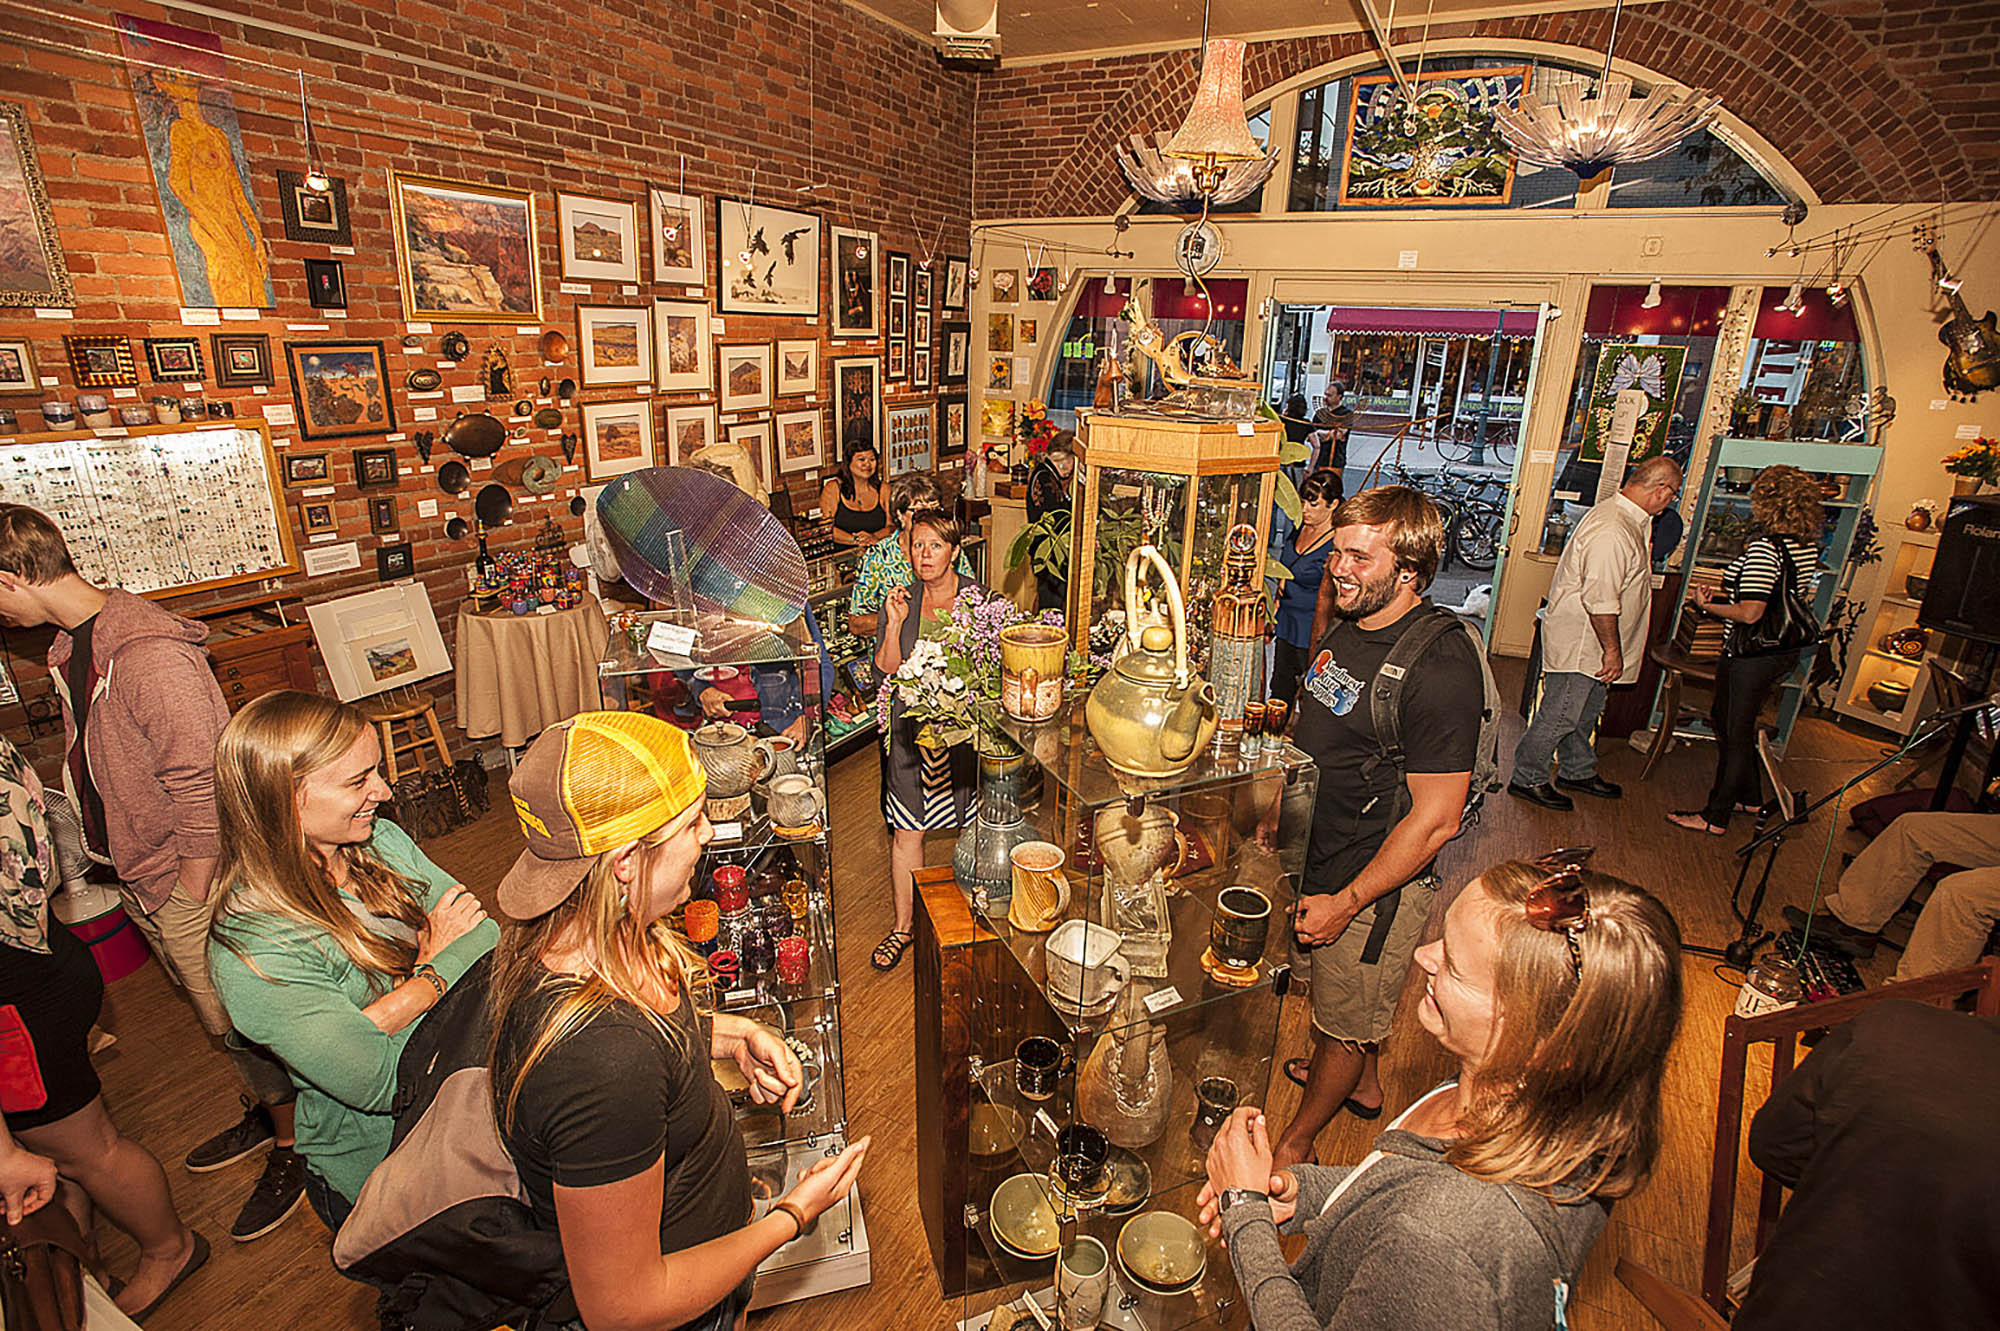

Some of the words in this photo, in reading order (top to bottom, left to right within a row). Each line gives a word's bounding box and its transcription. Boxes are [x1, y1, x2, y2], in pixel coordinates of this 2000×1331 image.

[1460, 401, 1493, 410] Arizoa
[1319, 671, 1341, 693] River
[1322, 659, 1366, 692] Northwest
[1311, 678, 1339, 707] Supplies
